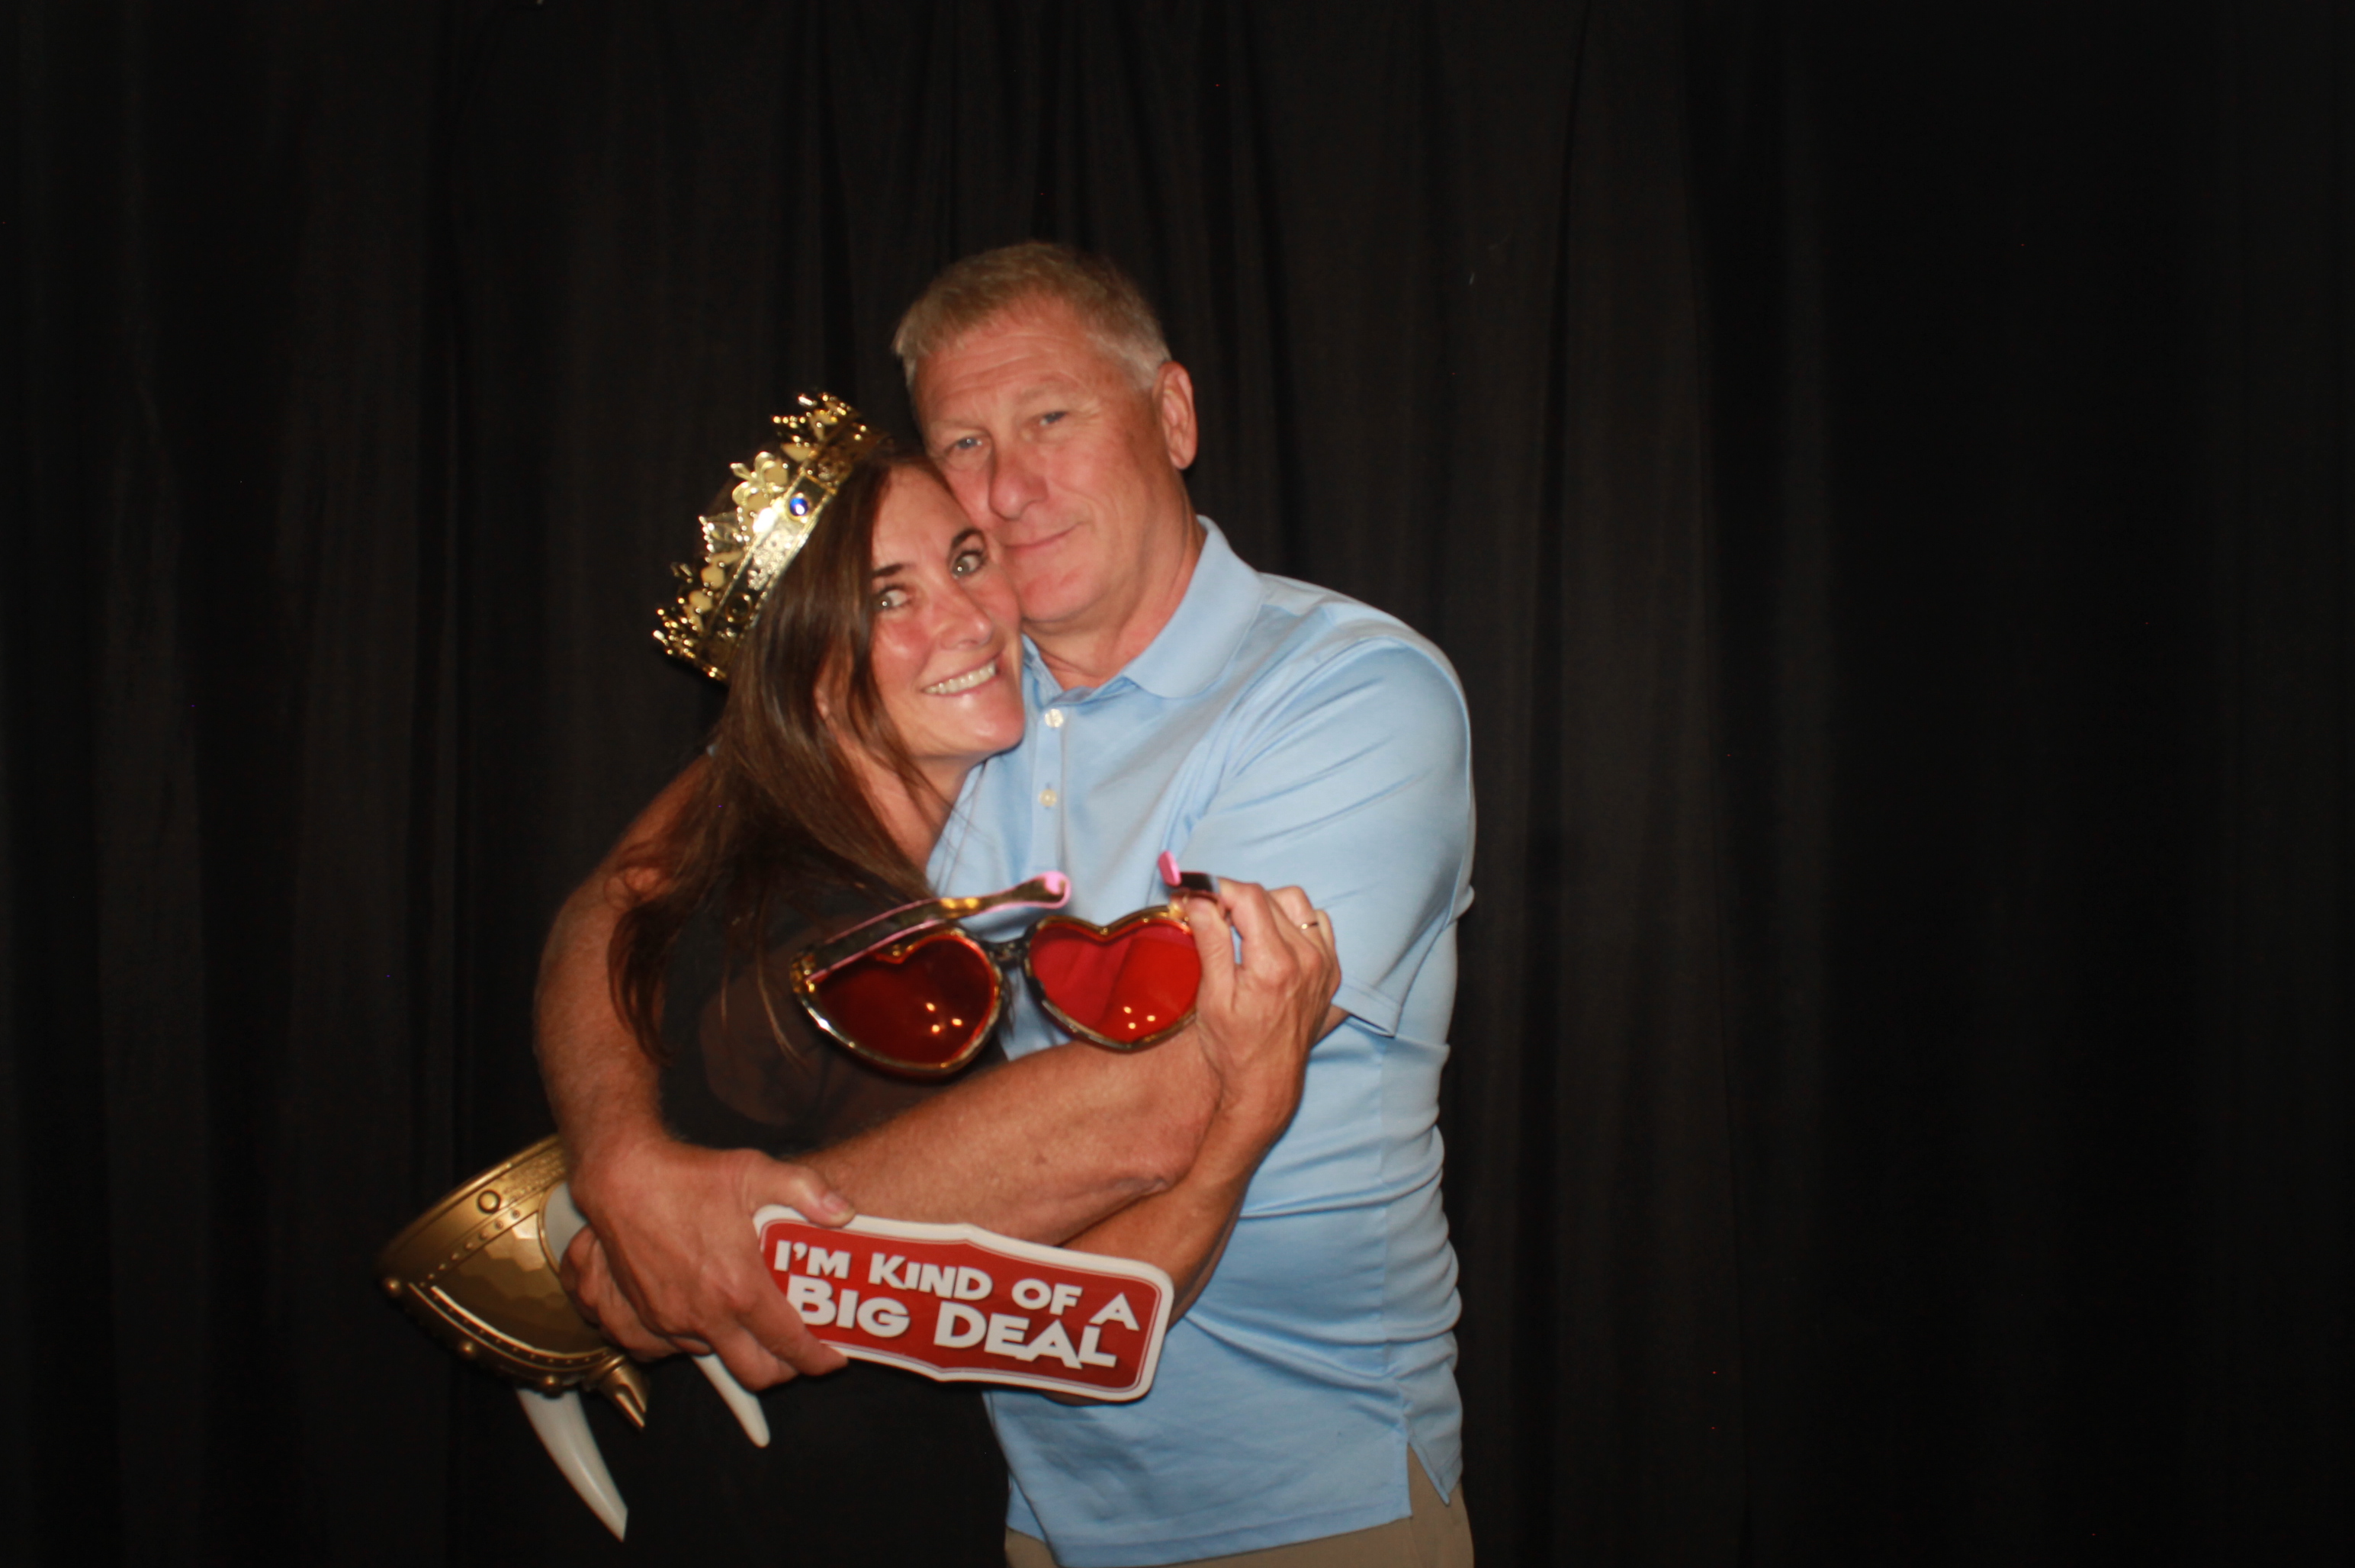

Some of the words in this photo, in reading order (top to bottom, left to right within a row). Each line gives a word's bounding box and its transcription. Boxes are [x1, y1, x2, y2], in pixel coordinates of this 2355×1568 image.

[774, 1240, 850, 1279] I'M
[868, 1253, 992, 1300] KIND
[1011, 1278, 1082, 1315] OF
[1089, 1292, 1139, 1331] A
[786, 1274, 910, 1338] BIG
[933, 1300, 1117, 1370] DEAL
